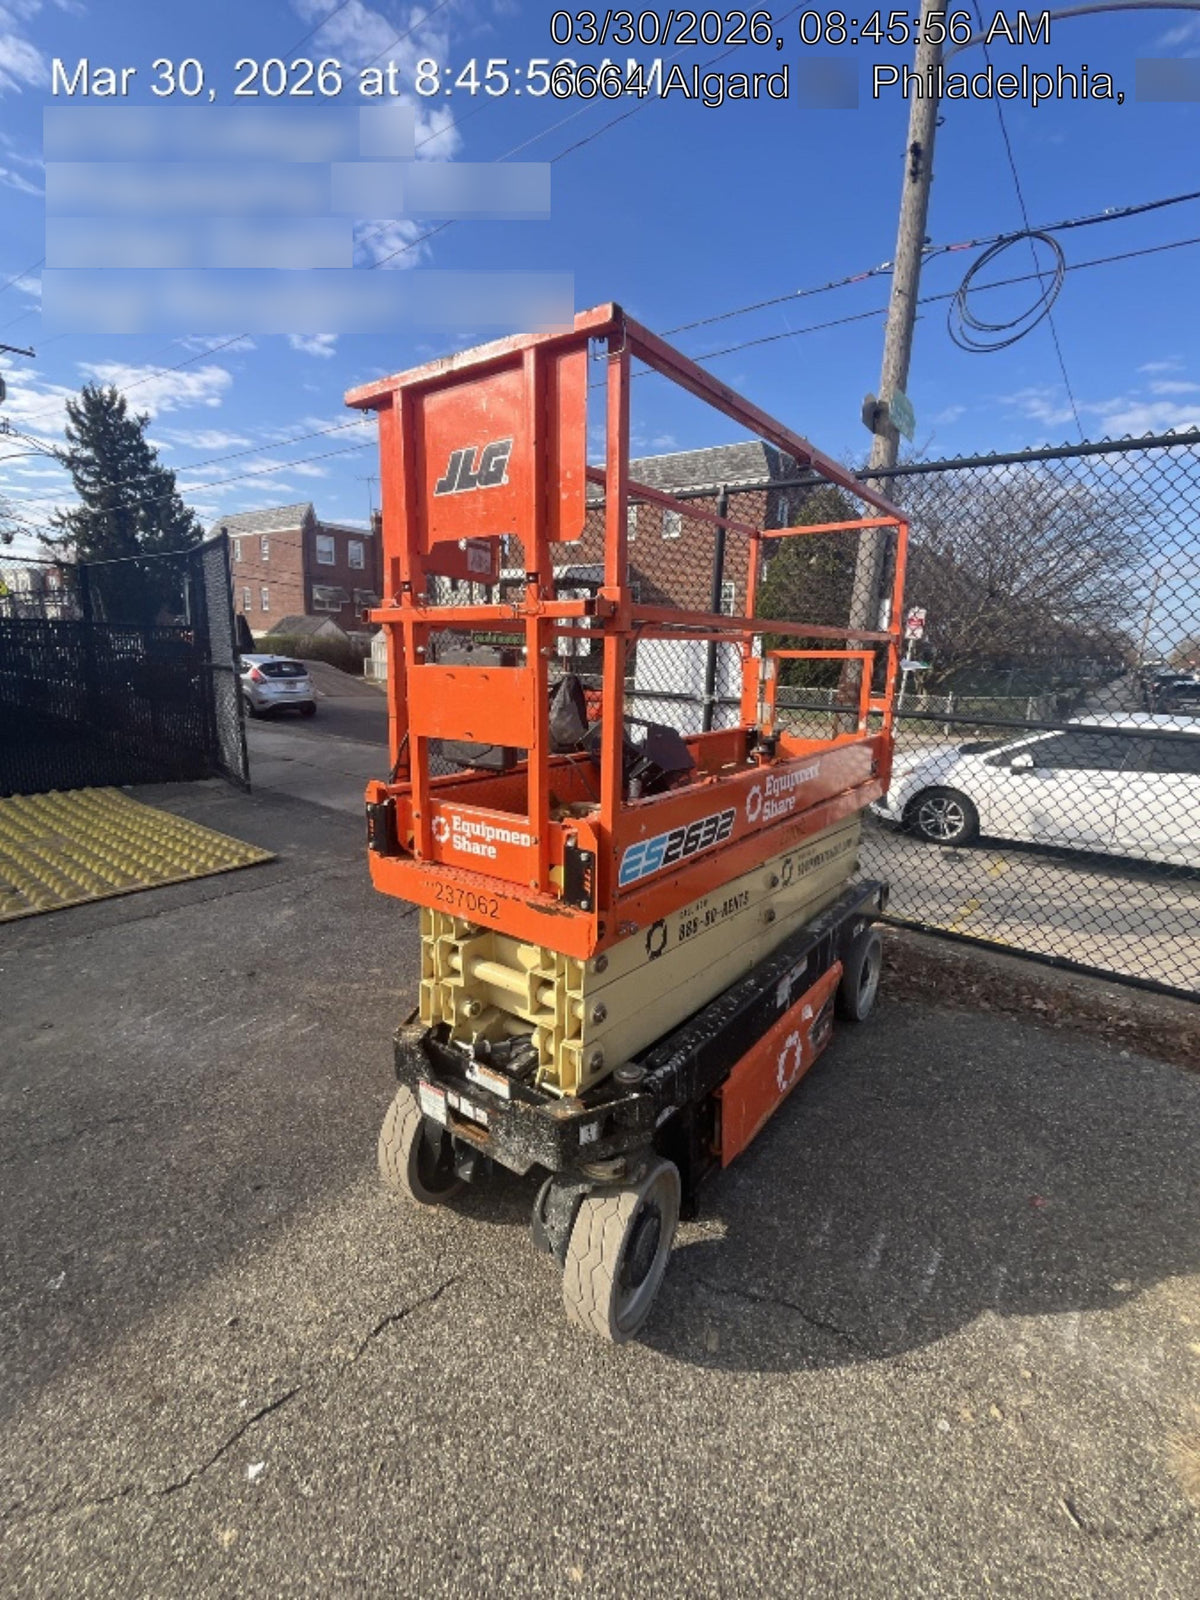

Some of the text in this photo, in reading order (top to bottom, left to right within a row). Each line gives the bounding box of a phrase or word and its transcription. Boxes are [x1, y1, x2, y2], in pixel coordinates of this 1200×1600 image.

[434, 438, 513, 497] JLG
[763, 796, 796, 822] Share
[452, 815, 531, 847] Equipmen
[452, 834, 497, 859] Share
[618, 807, 737, 887] ES2632
[435, 881, 501, 920] 237062
